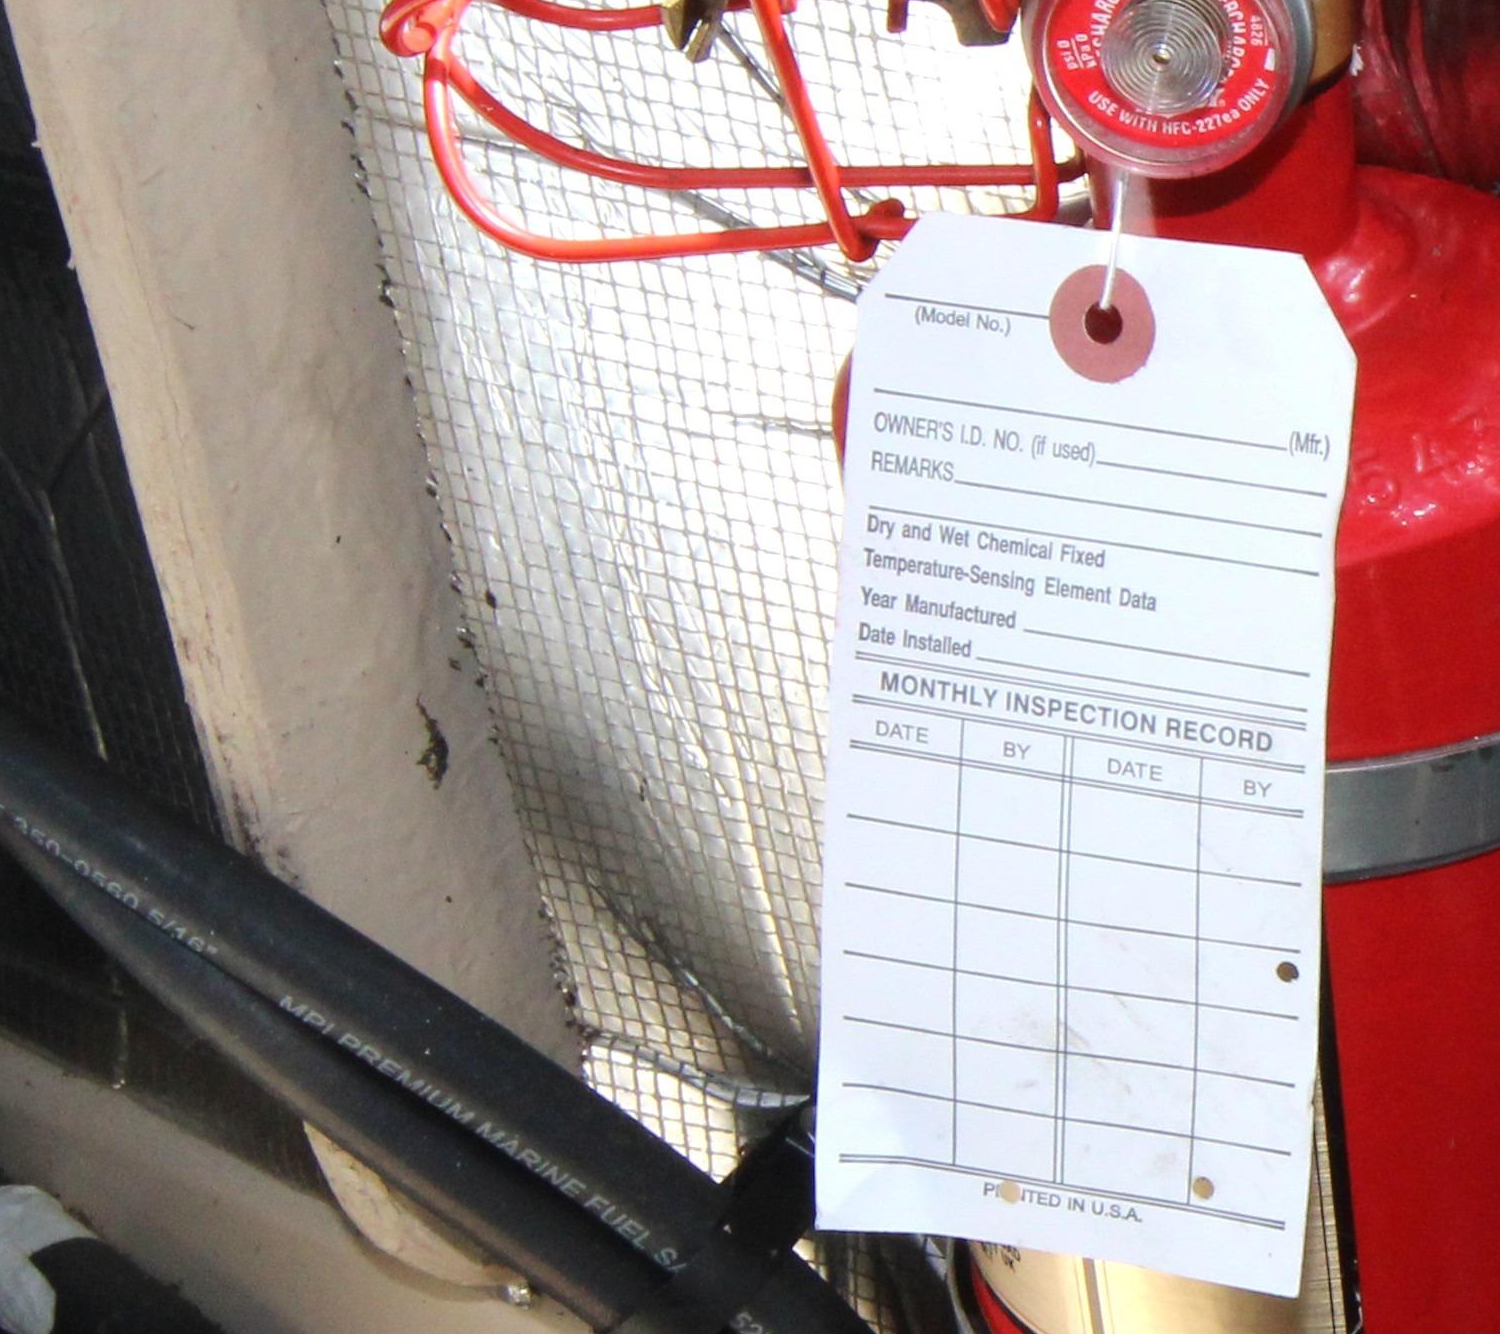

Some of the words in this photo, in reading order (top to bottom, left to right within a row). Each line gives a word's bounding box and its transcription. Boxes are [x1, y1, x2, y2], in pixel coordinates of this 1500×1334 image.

[1088, 91, 1117, 117] USE
[1119, 111, 1157, 134] WITH
[1239, 77, 1271, 112] ONLY
[915, 305, 972, 329] (Model
[976, 313, 1012, 336] No.)
[873, 412, 955, 446] OWNER'S
[960, 425, 987, 449] I.D.
[993, 429, 1024, 454] NO.
[1031, 435, 1047, 459] (if
[1052, 439, 1097, 464] used)
[1288, 432, 1330, 462] (Mfr.)
[871, 452, 955, 482] REMARKS
[867, 515, 895, 542] Dry
[902, 520, 932, 543] and
[939, 525, 969, 549] Wet
[977, 531, 1053, 561] Chemical
[1060, 543, 1106, 568] Fixed
[864, 548, 1035, 597] Temperature-Sensing
[1045, 576, 1112, 606] Element
[1119, 585, 1157, 612] Data
[860, 587, 896, 611] Year
[905, 594, 1017, 630] Manufactured
[858, 623, 895, 646] Date
[903, 629, 972, 659] Installed
[881, 671, 998, 708] MONTHLY
[1005, 691, 1157, 734] INSPECTION
[1165, 718, 1274, 753] RECORD
[875, 720, 930, 745] DATE
[1003, 741, 1031, 760] BY
[1107, 757, 1163, 782] DATE
[1243, 779, 1273, 799] BY
[279, 995, 335, 1035] MPI
[338, 1033, 475, 1125] PREMIUM
[479, 1121, 584, 1195] MARINE
[585, 1188, 654, 1248] FUEL
[1067, 1196, 1086, 1213] IN
[1092, 1202, 1143, 1223] U.S.A.
